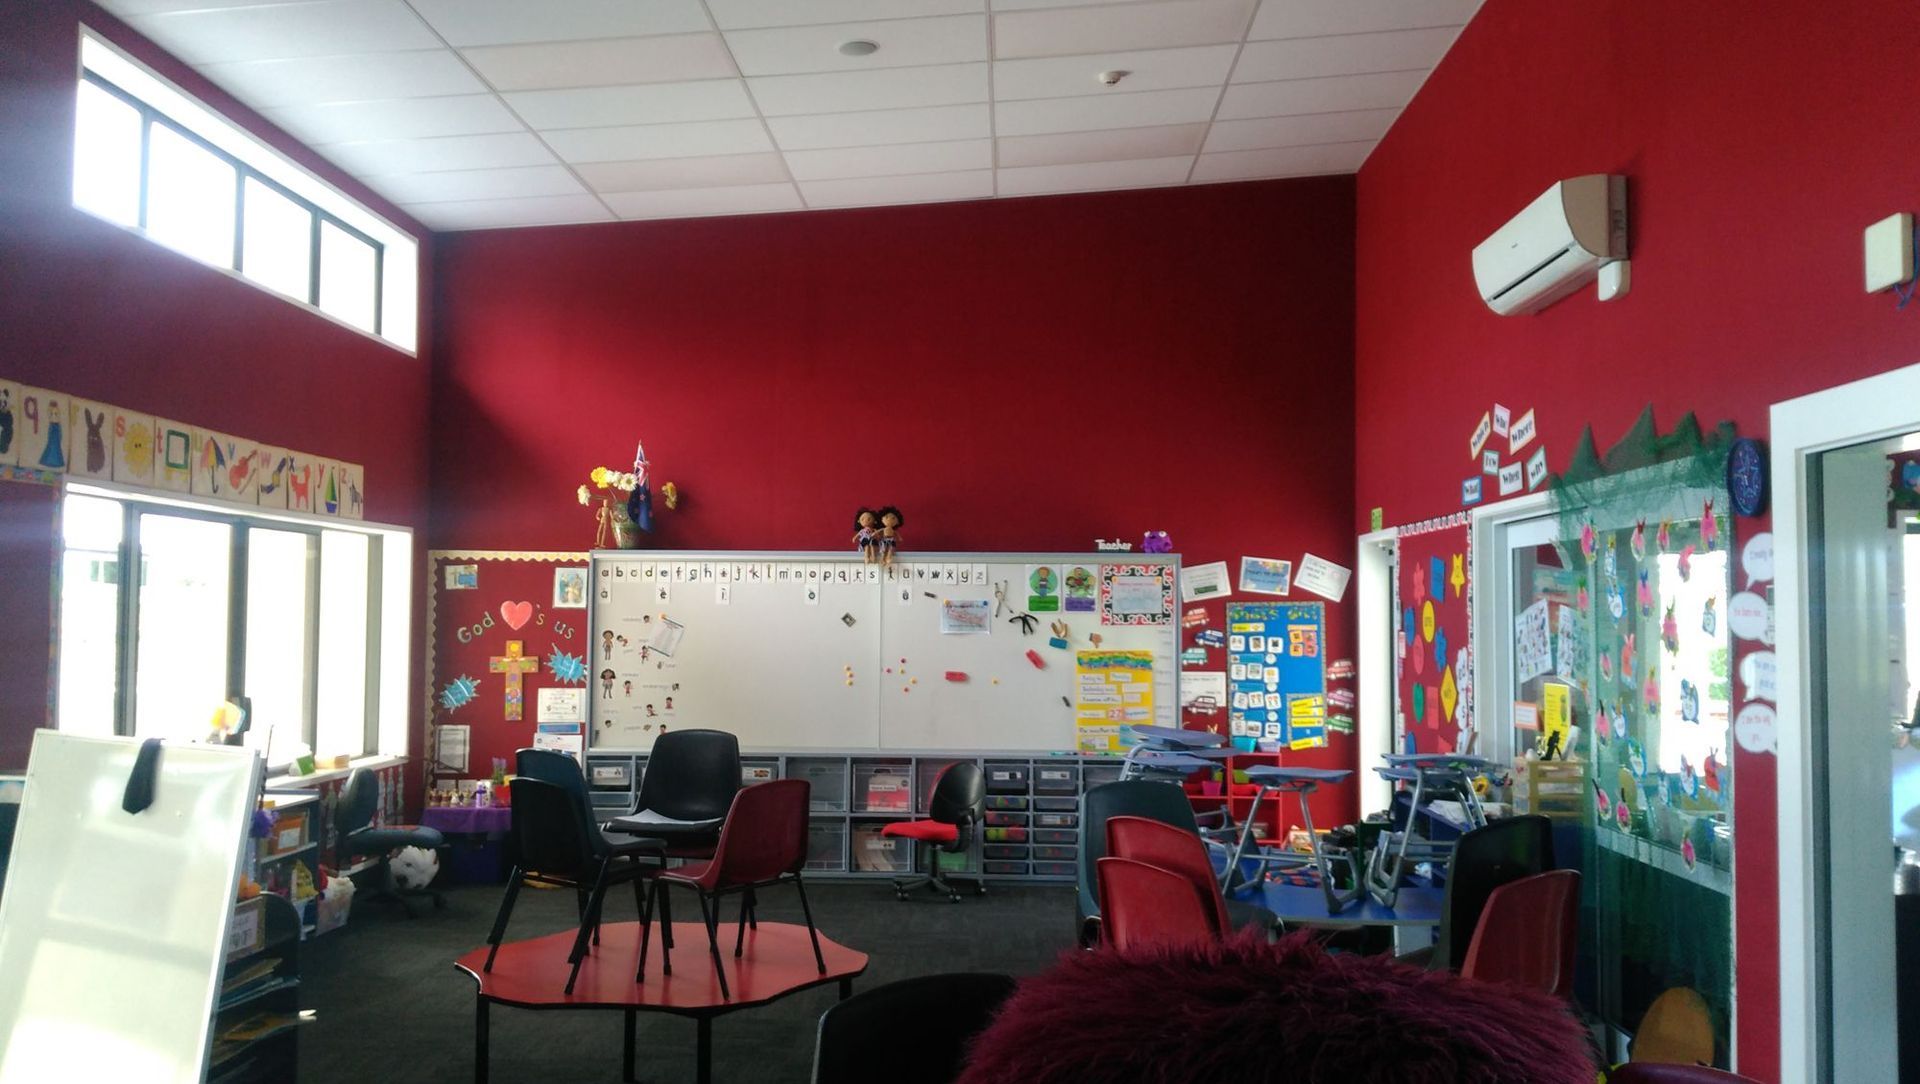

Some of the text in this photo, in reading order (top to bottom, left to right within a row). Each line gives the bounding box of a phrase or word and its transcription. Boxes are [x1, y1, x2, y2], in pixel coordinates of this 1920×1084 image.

[23, 396, 39, 434] q
[115, 415, 126, 438] s
[156, 426, 163, 454] t
[227, 442, 236, 460] v
[260, 451, 272, 469] w
[288, 456, 296, 472] x
[317, 464, 325, 489] y
[1094, 538, 1132, 551] Teacher
[602, 569, 609, 577] a
[616, 566, 623, 577] b
[630, 569, 637, 577] c
[645, 566, 653, 577] d
[660, 569, 668, 577] e
[676, 566, 682, 579] f
[704, 563, 712, 578] h
[734, 566, 741, 581] j
[749, 564, 760, 579] k
[779, 568, 789, 579] m
[795, 570, 802, 578] n
[809, 570, 817, 578] o
[823, 570, 831, 582] p
[838, 570, 847, 582] q
[869, 570, 876, 579] s
[946, 569, 954, 580] x
[961, 570, 969, 583] y
[457, 611, 495, 644] God
[554, 620, 575, 640] us
